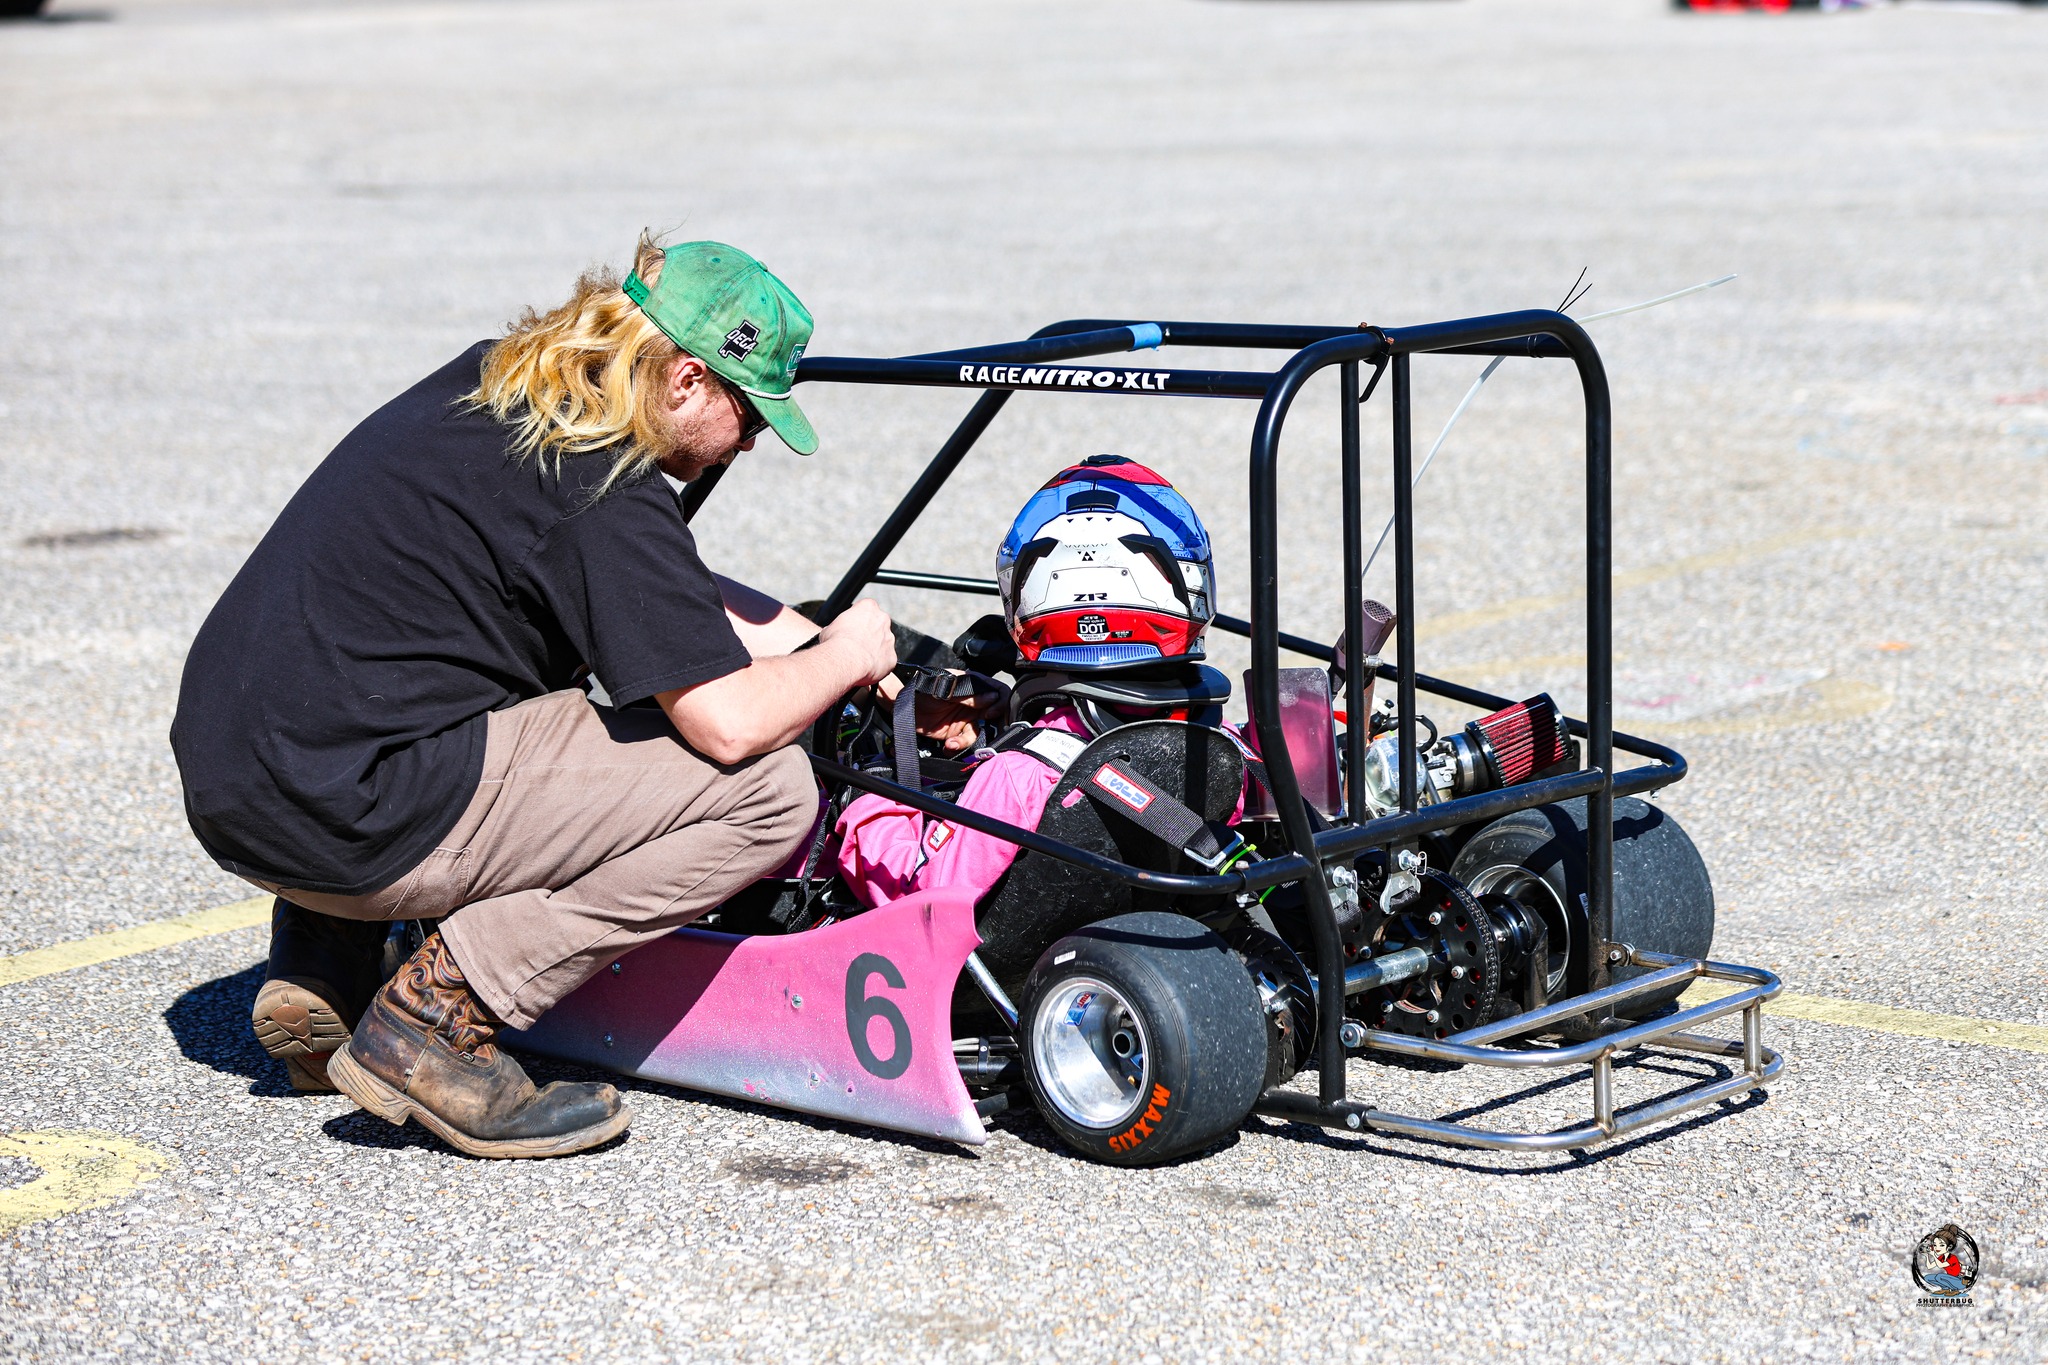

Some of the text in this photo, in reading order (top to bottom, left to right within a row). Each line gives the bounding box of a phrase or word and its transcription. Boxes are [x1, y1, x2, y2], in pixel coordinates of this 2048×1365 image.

[725, 329, 758, 351] DEGA
[1080, 623, 1105, 634] DOT
[1109, 778, 1147, 806] RJS
[845, 952, 913, 1079] 6
[1108, 1082, 1171, 1153] MAXXIS
